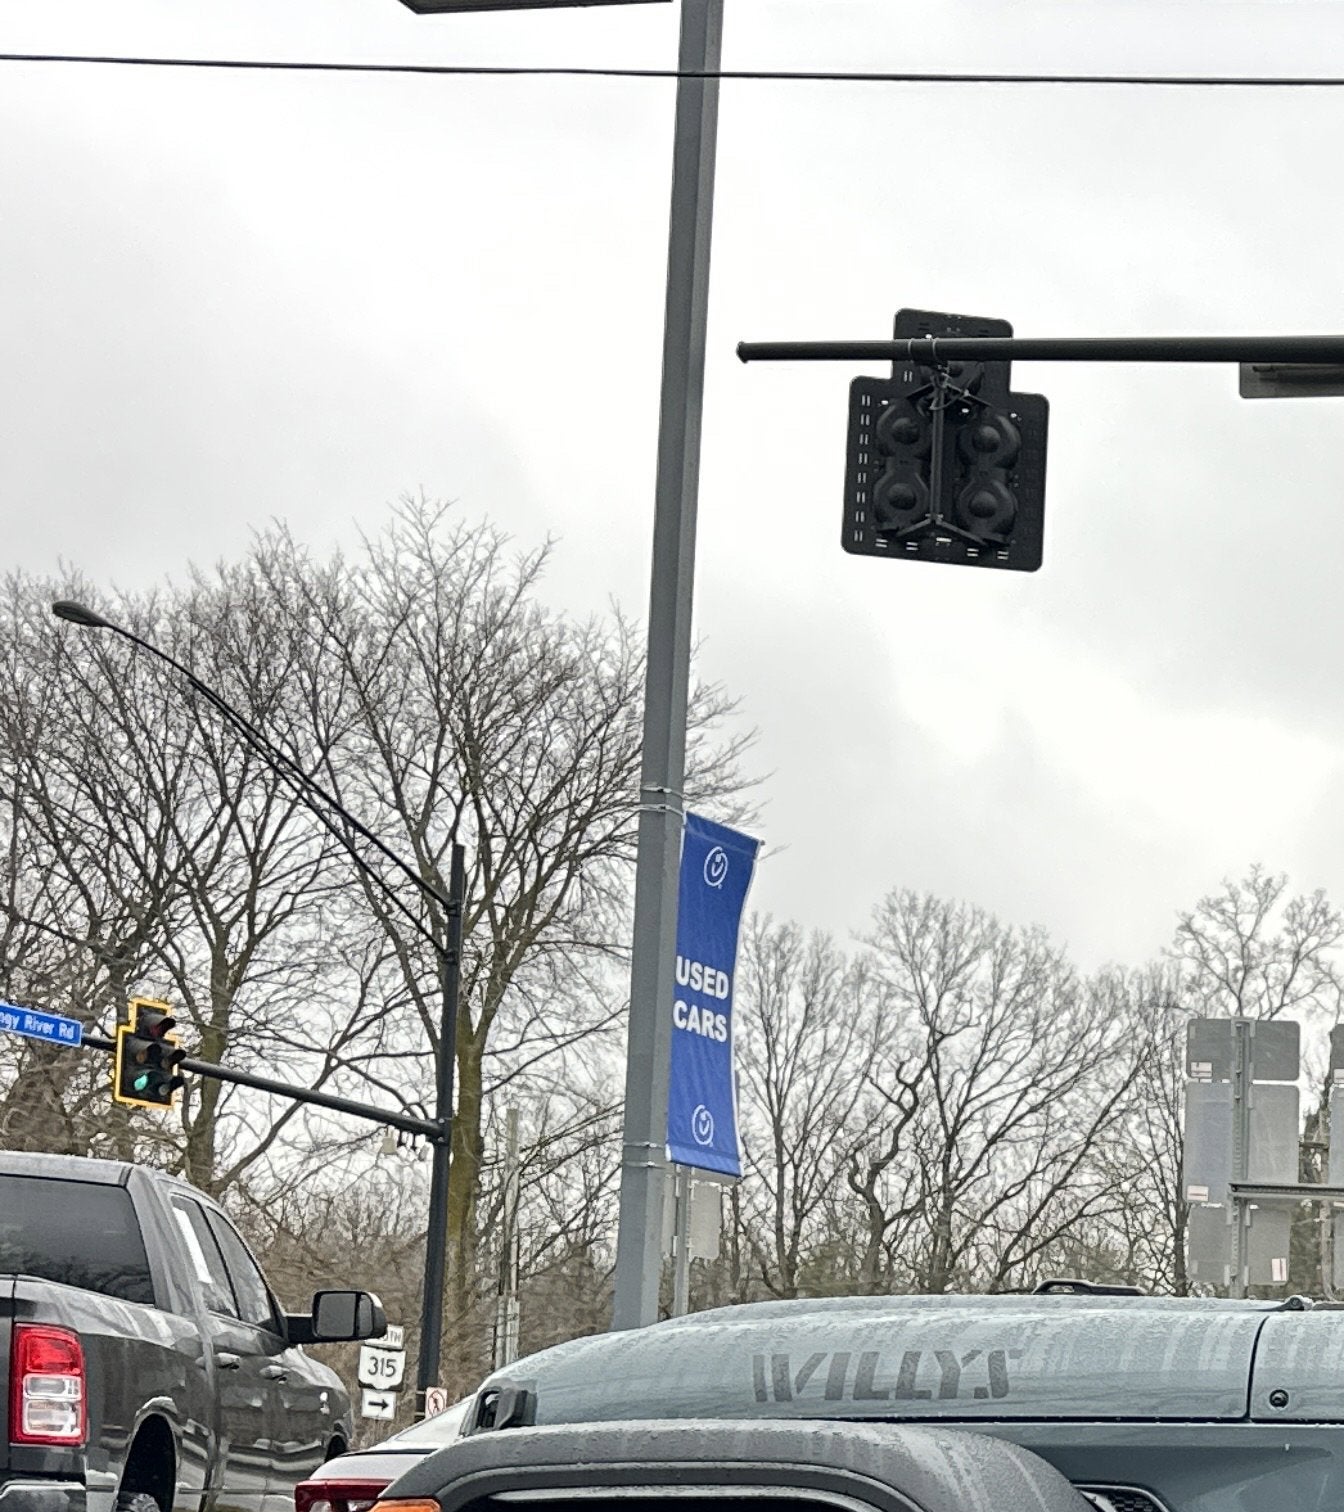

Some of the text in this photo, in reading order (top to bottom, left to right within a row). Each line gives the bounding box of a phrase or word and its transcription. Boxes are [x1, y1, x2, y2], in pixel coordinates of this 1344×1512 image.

[675, 955, 729, 1000] USED
[24, 1014, 55, 1035] River
[59, 1022, 75, 1040] Rd
[673, 1000, 727, 1043] CARS
[367, 1356, 397, 1378] 315
[752, 1349, 1024, 1402] WILLYS
